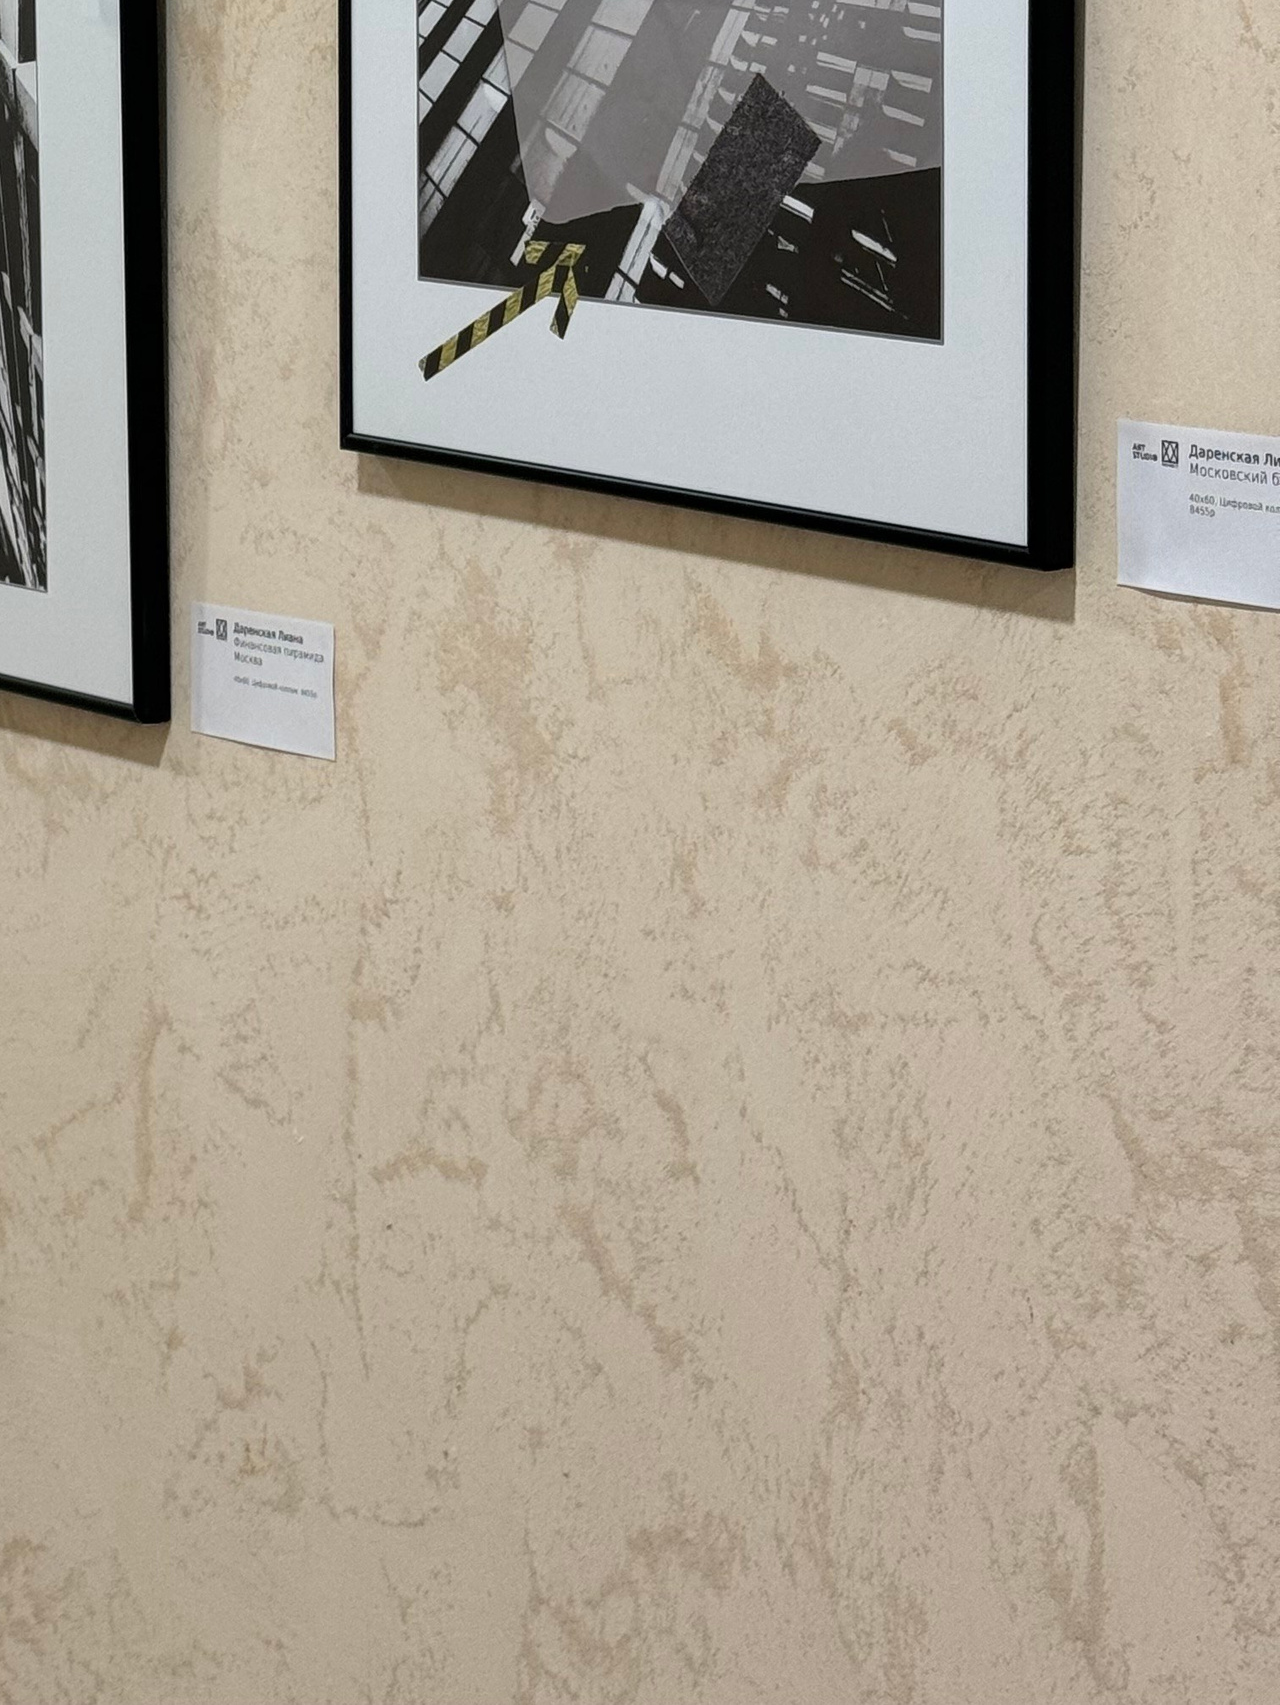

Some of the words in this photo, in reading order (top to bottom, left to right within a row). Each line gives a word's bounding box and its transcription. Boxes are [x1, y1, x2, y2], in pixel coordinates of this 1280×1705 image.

[1188, 444, 1260, 465] Даренская
[1189, 462, 1268, 485] Московский
[233, 651, 263, 666] Москва
